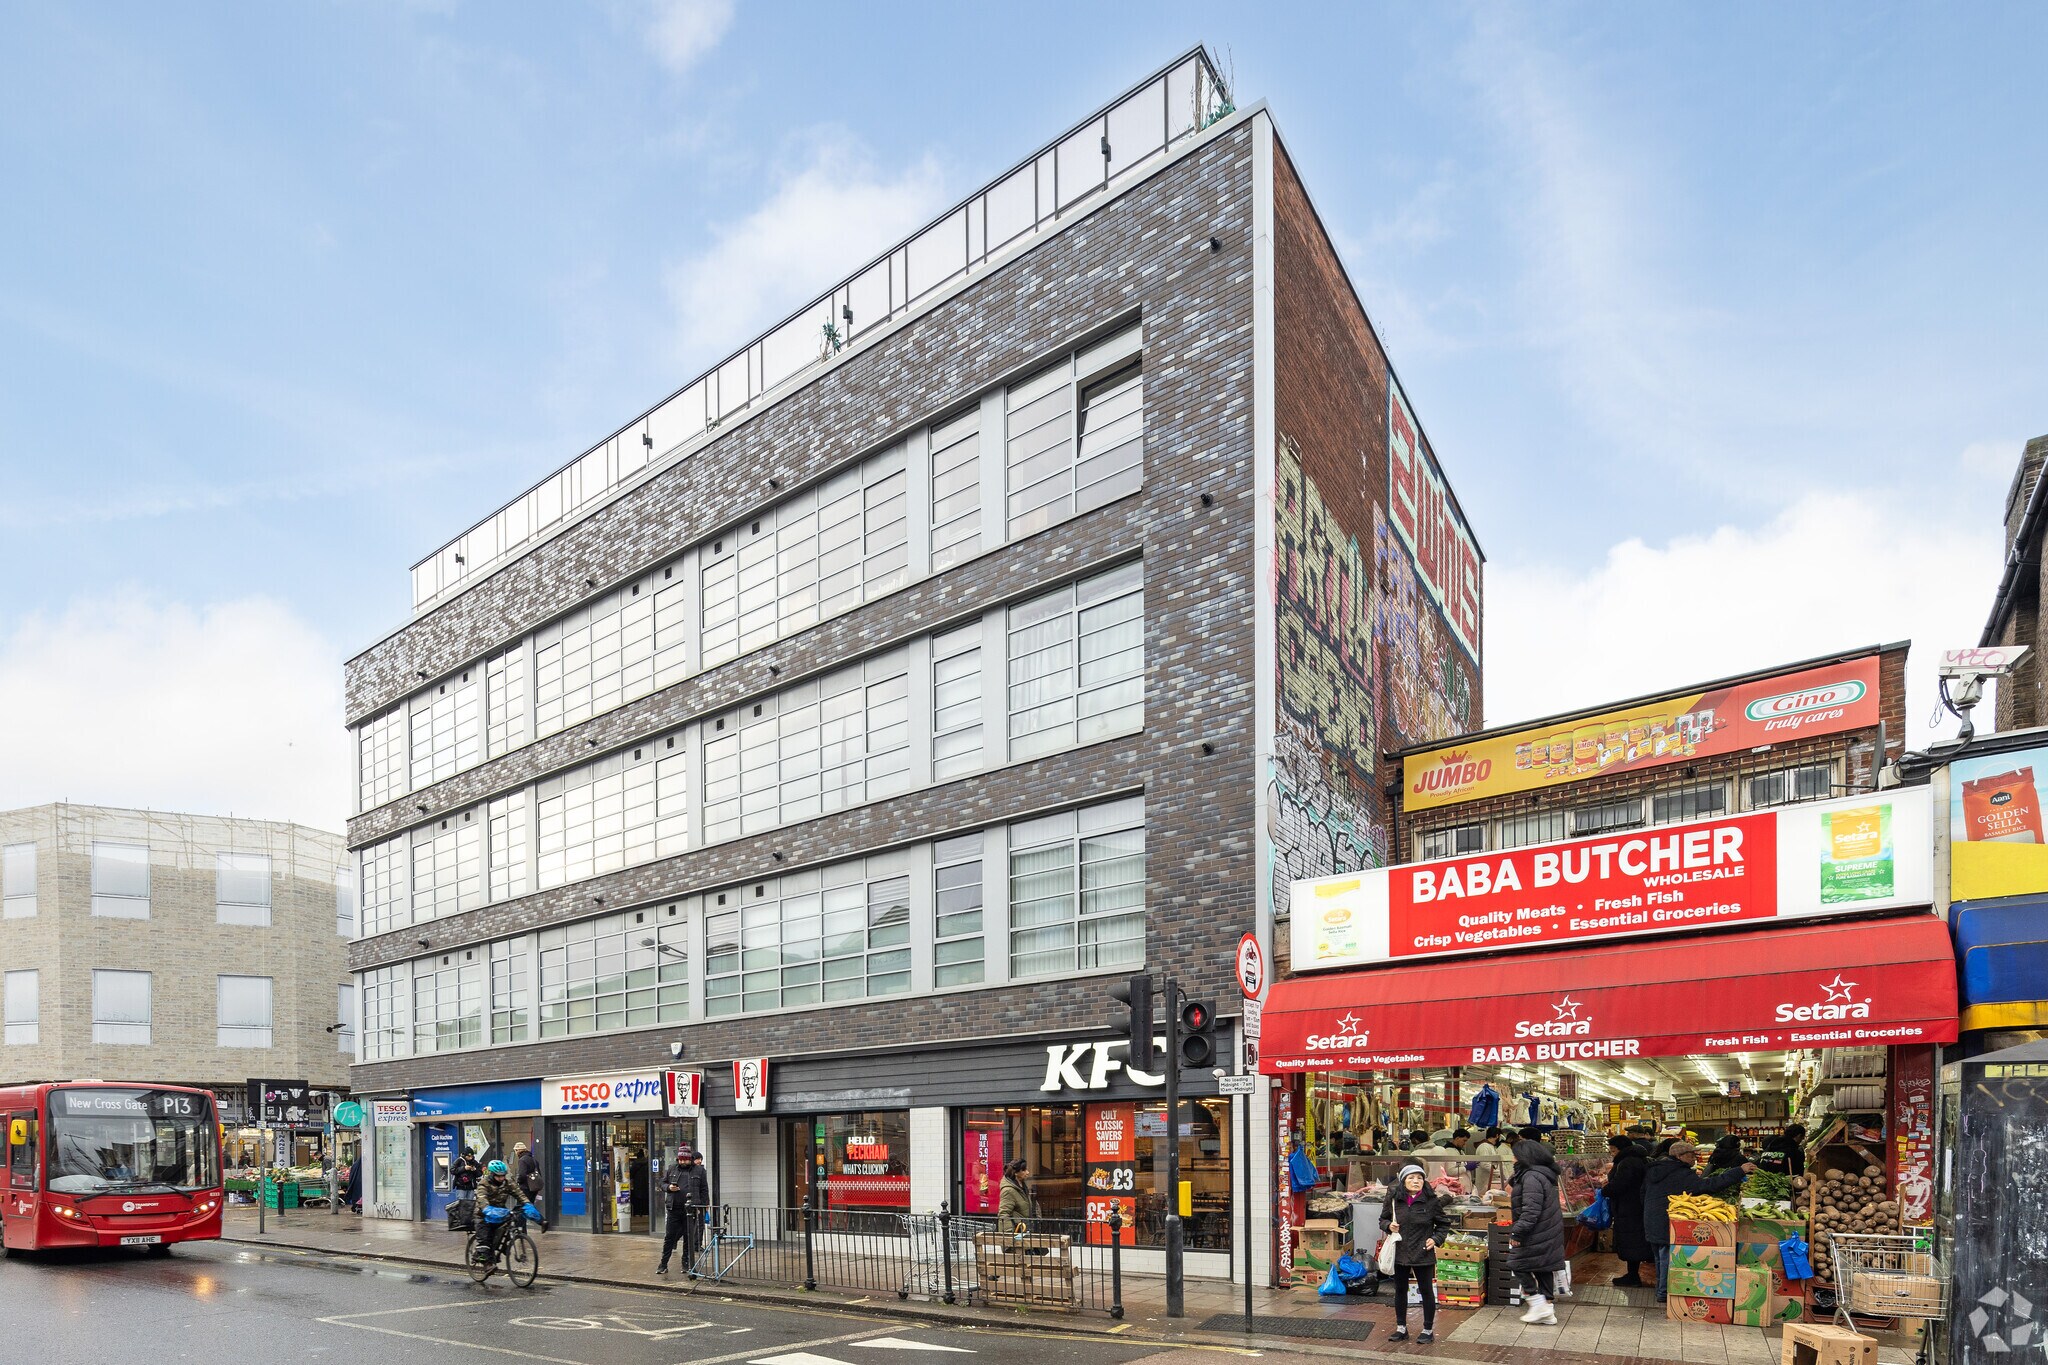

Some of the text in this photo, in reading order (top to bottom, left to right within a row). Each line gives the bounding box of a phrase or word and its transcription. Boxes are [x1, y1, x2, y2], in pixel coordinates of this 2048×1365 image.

[1773, 691, 1835, 712] Gino
[1764, 707, 1844, 731] truly cares
[1413, 758, 1492, 794] JUMBO
[1429, 786, 1475, 799] Proudly African
[1977, 806, 2029, 824] GOLDEN
[1987, 817, 2022, 831] SELLA
[1834, 831, 1878, 843] Setara
[1984, 828, 2011, 838] BASMATI
[1412, 826, 1744, 904] BABA BUTCHER
[1834, 861, 1878, 873] SUPREME
[1643, 865, 1744, 888] WHOLESALE
[1458, 889, 1684, 928] Quality Meats Fresh Fish
[1413, 901, 1741, 949] Crisp Vegetables Essential Groceries
[1774, 1001, 1869, 1023] Setara
[1514, 1019, 1591, 1038] Setara
[1705, 1025, 1923, 1047] Fresh Fish Essential Groceries
[1305, 1033, 1368, 1050] Setara
[1471, 1039, 1640, 1063] BABA BUTCHER
[1275, 1053, 1425, 1068] Quality Meats Crisp Vegetables
[560, 1078, 663, 1103] TESCO expre
[69, 1097, 148, 1110] New Cross Gate
[163, 1098, 191, 1114] P13
[673, 1105, 695, 1116] KFC
[377, 1115, 408, 1123] express
[1100, 1110, 1117, 1120] CULT
[1095, 1120, 1123, 1131] CLASSIC
[563, 1134, 580, 1142] Hello.
[847, 1136, 876, 1145] HELLO
[1096, 1131, 1123, 1141] SAVERS
[847, 1144, 888, 1160] PECKHAM
[1100, 1141, 1119, 1151] MENU
[842, 1163, 862, 1175] WHAT'S
[1113, 1168, 1134, 1191] £3
